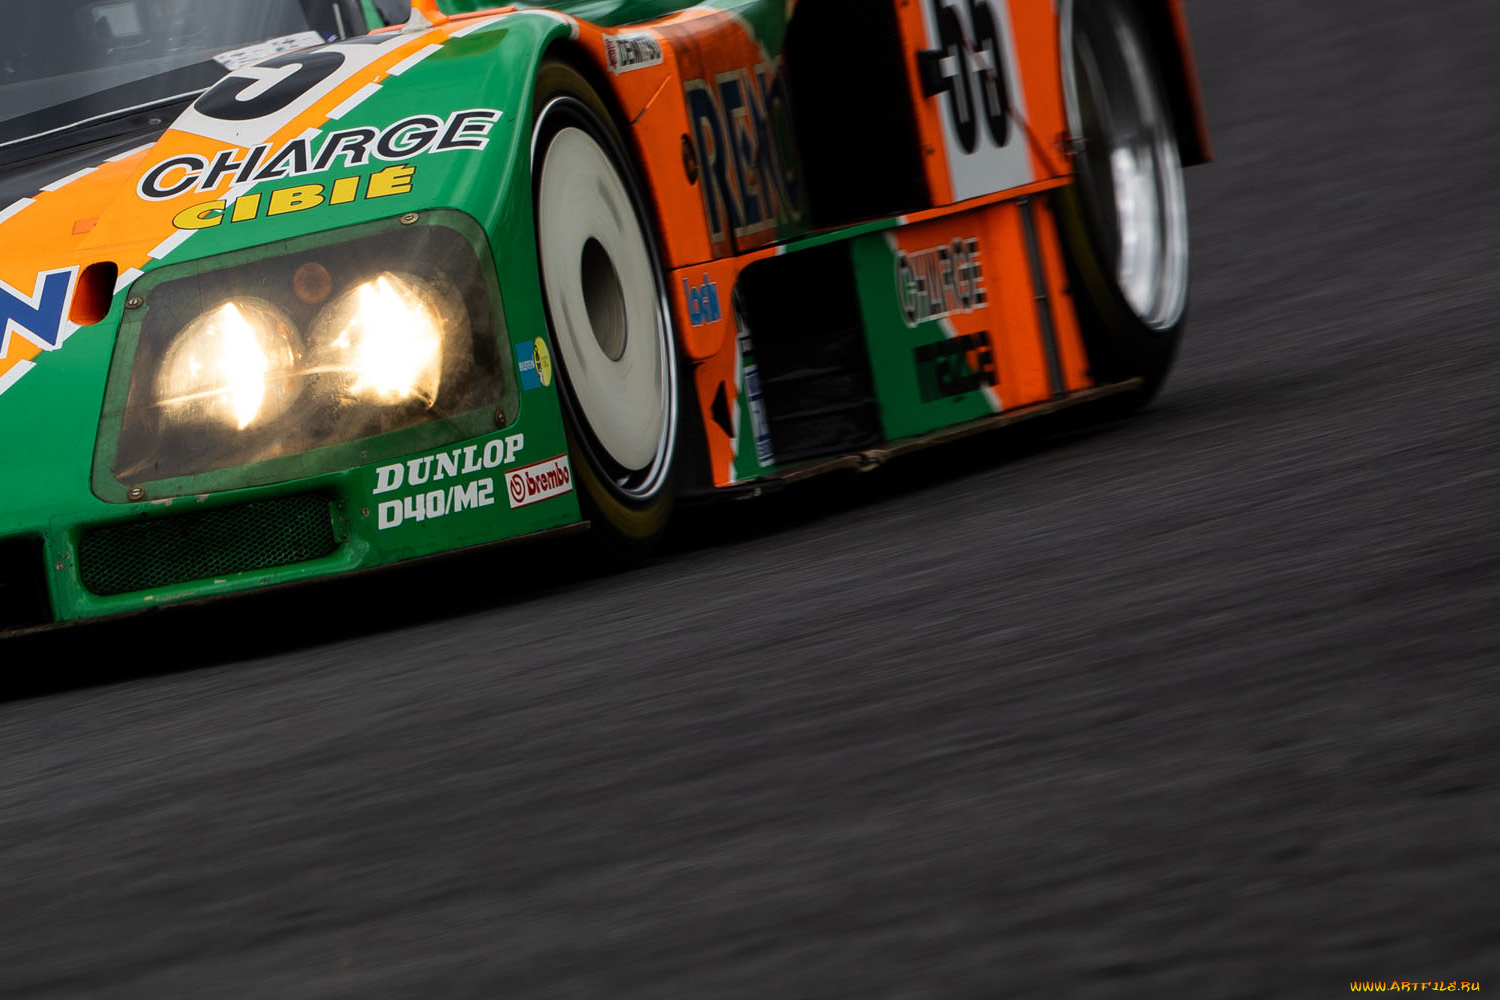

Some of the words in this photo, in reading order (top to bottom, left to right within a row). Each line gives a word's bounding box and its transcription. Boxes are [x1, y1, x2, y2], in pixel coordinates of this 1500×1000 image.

[137, 109, 502, 201] CHARGE
[372, 433, 524, 494] DUNLOP
[526, 462, 570, 496] brembo
